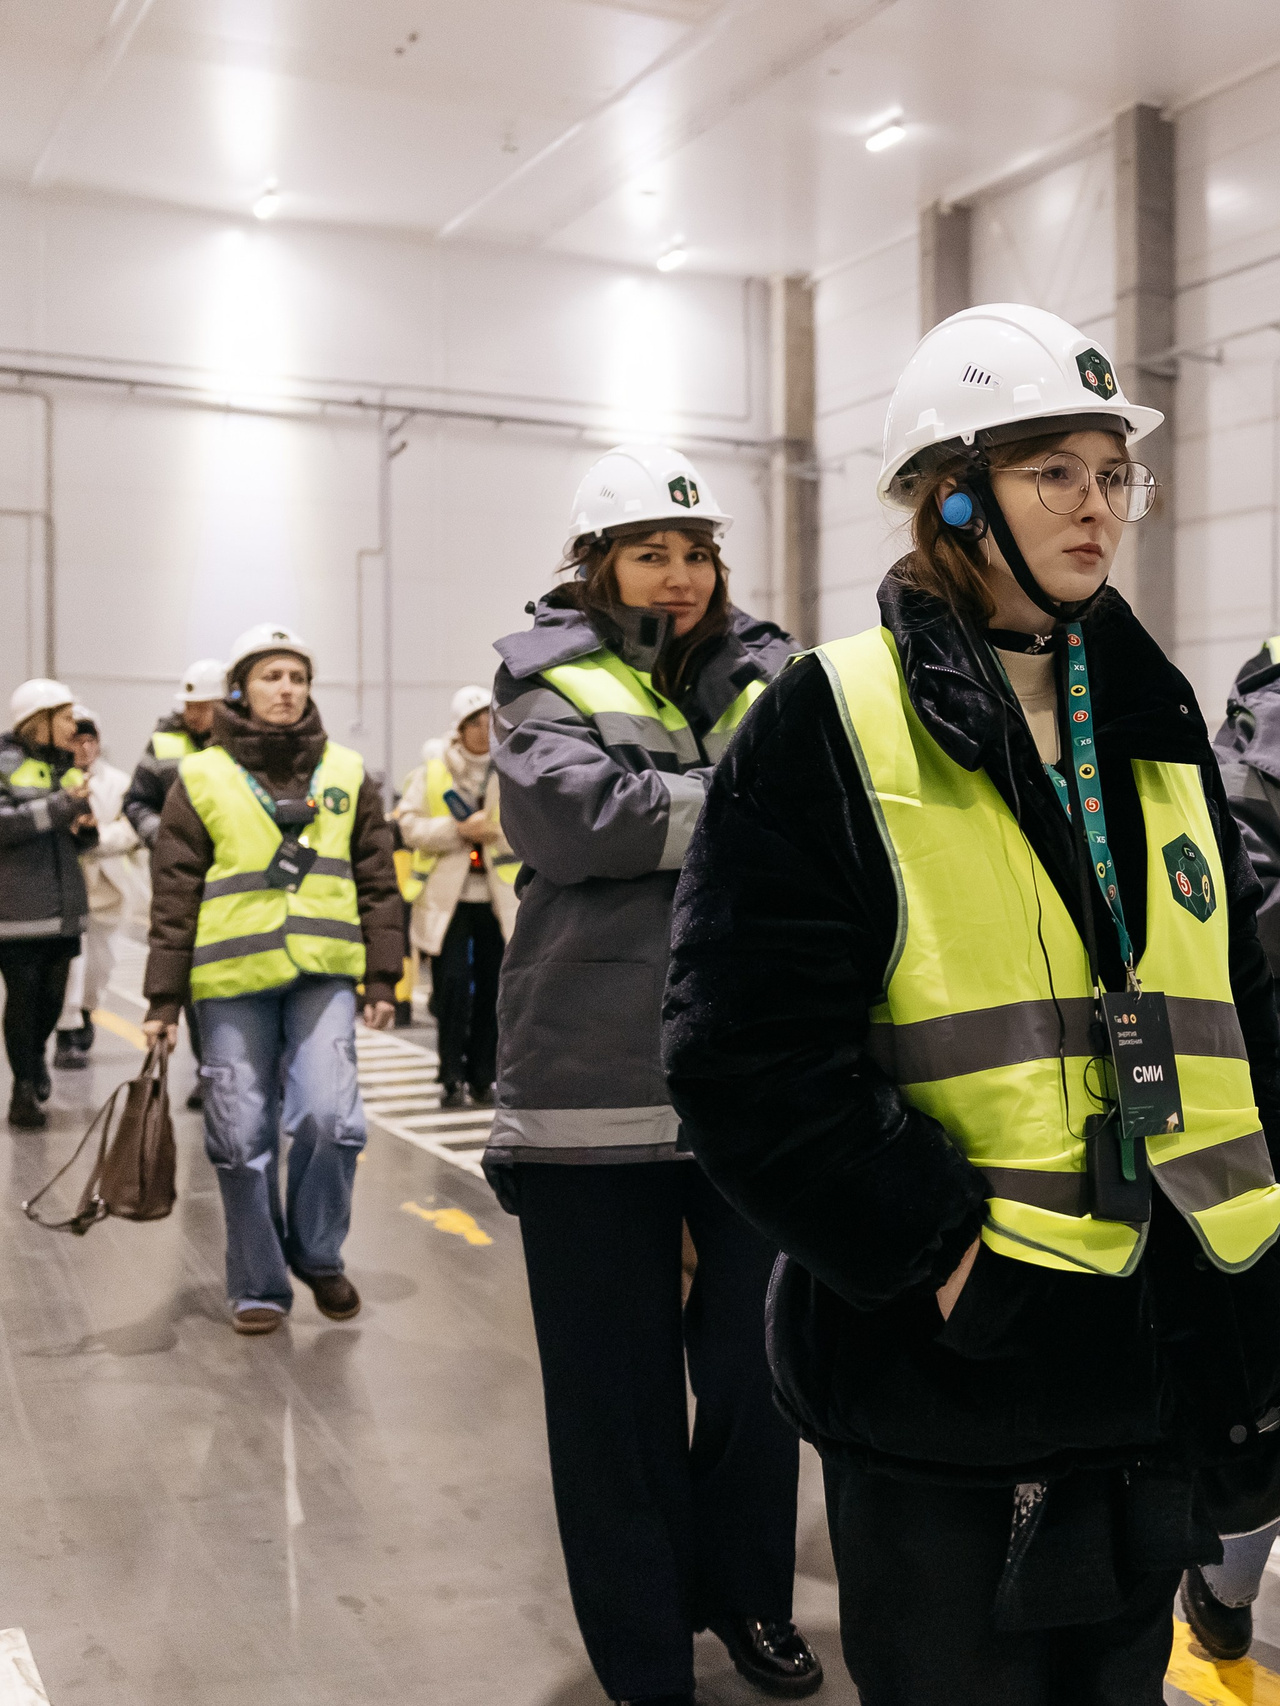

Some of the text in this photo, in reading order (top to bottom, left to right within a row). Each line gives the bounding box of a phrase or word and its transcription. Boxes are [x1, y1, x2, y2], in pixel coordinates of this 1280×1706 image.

[1080, 738, 1092, 746] X5
[1096, 836, 1106, 844] X5
[1132, 1065, 1164, 1083] СМИ
